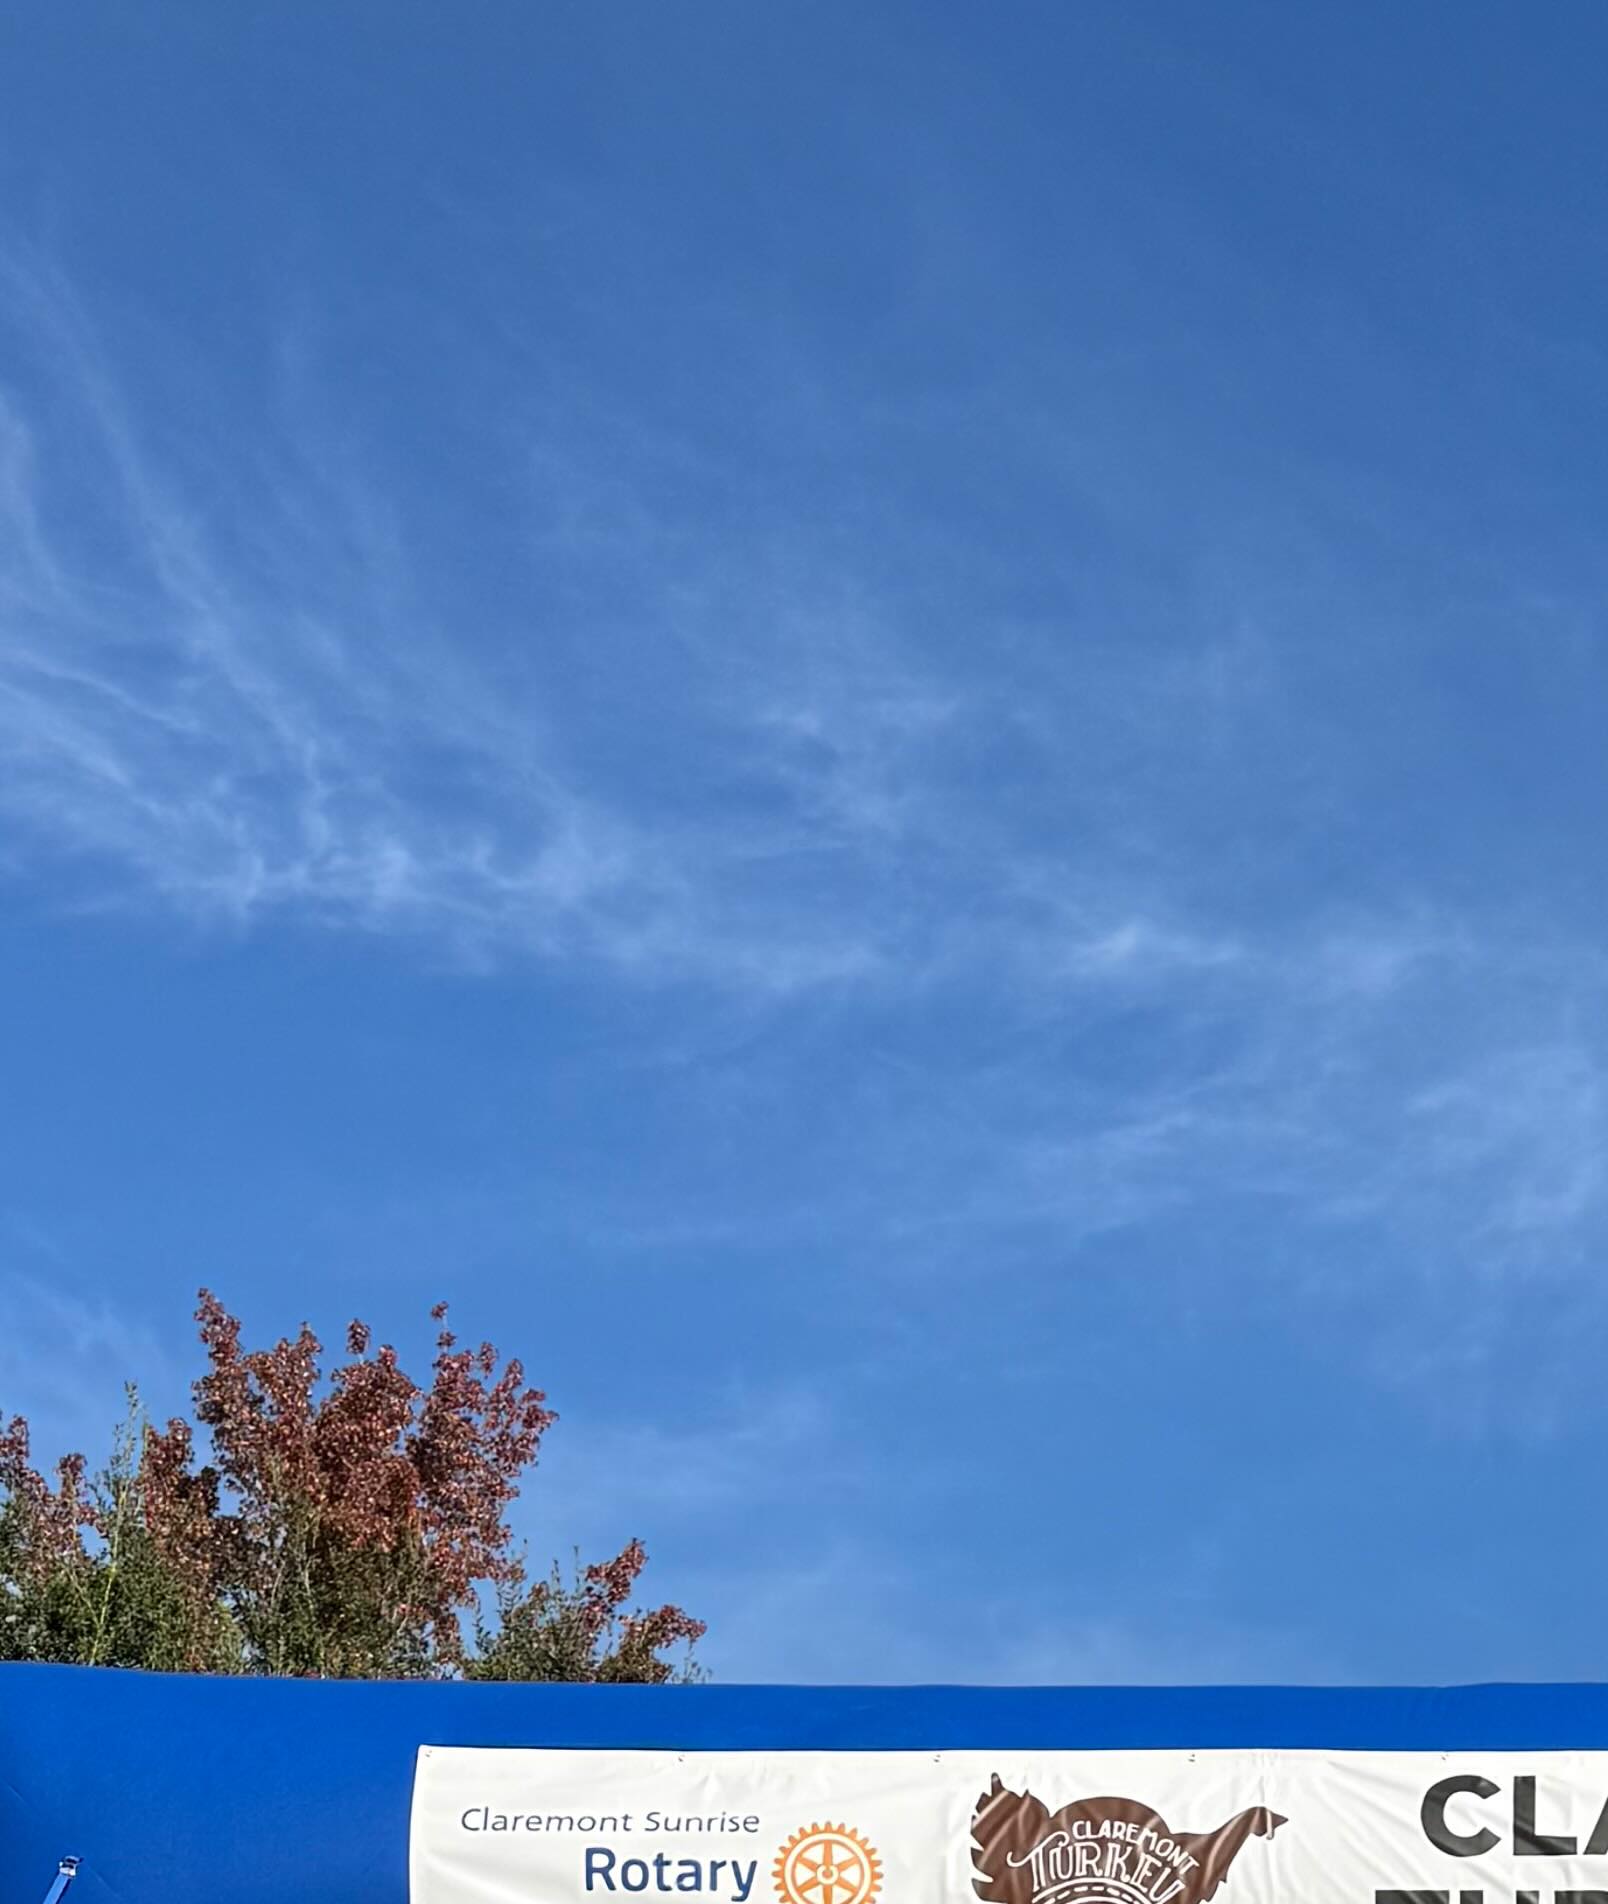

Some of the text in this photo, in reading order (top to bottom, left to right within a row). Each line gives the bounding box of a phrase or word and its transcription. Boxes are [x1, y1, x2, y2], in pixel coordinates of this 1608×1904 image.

[461, 1807, 760, 1835] Claremont Sunrise
[1073, 1819, 1200, 1875] CLAREMONT
[585, 1848, 758, 1902] Rotary
